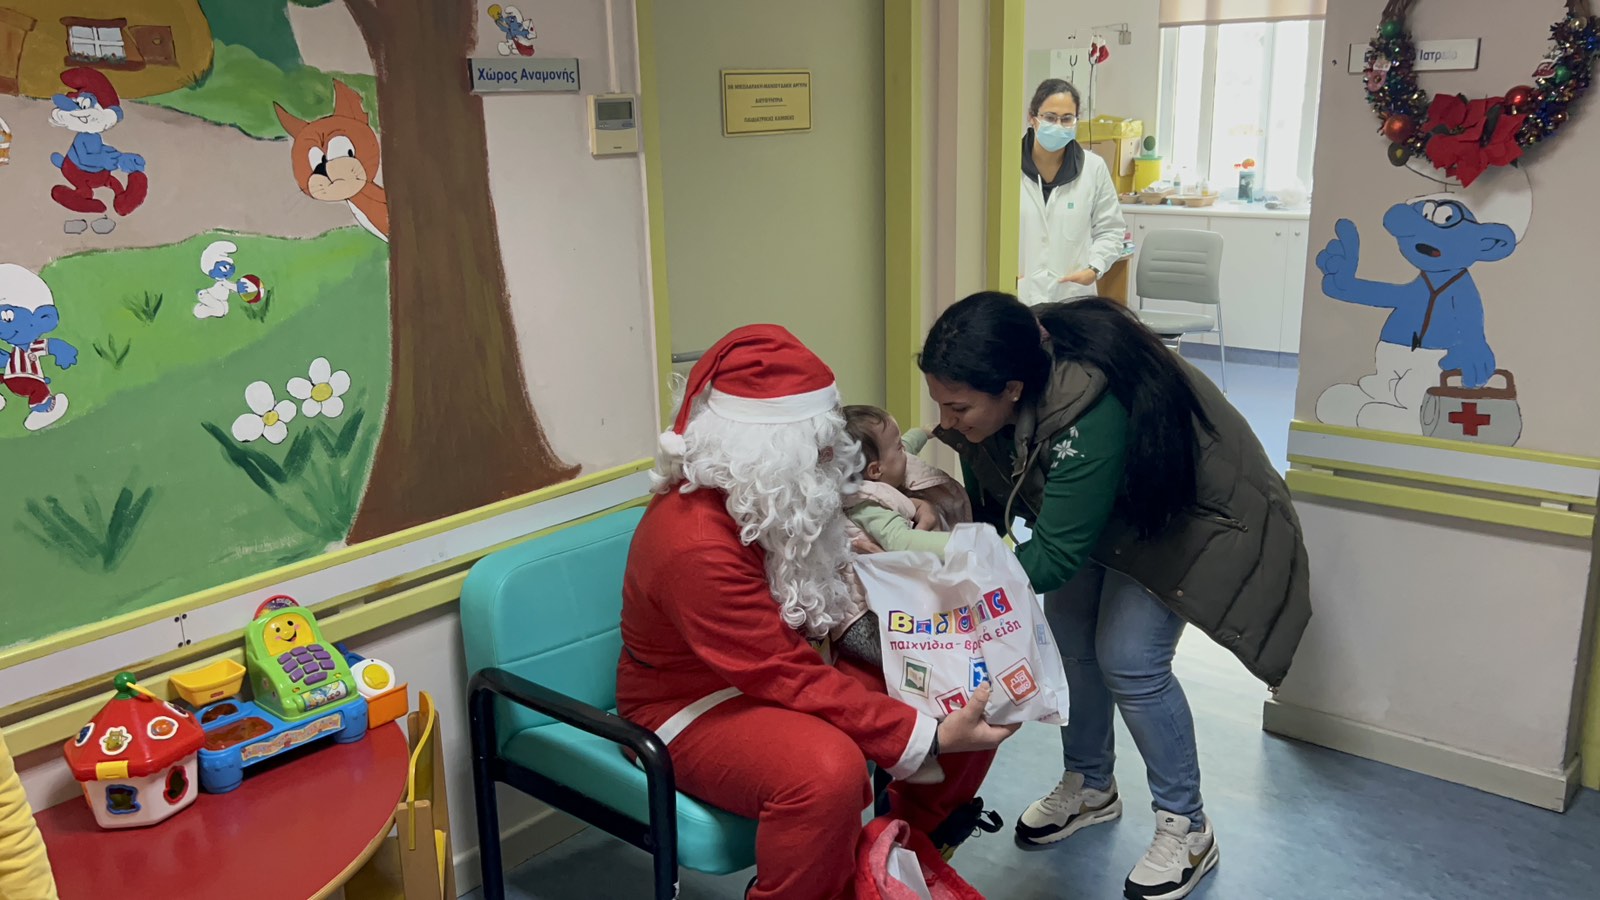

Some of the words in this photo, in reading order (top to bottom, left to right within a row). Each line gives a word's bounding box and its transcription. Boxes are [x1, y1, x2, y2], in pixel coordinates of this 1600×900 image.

[477, 67, 518, 84] Χώρος
[520, 67, 576, 83] Αναμονής
[994, 618, 1022, 638] είδη
